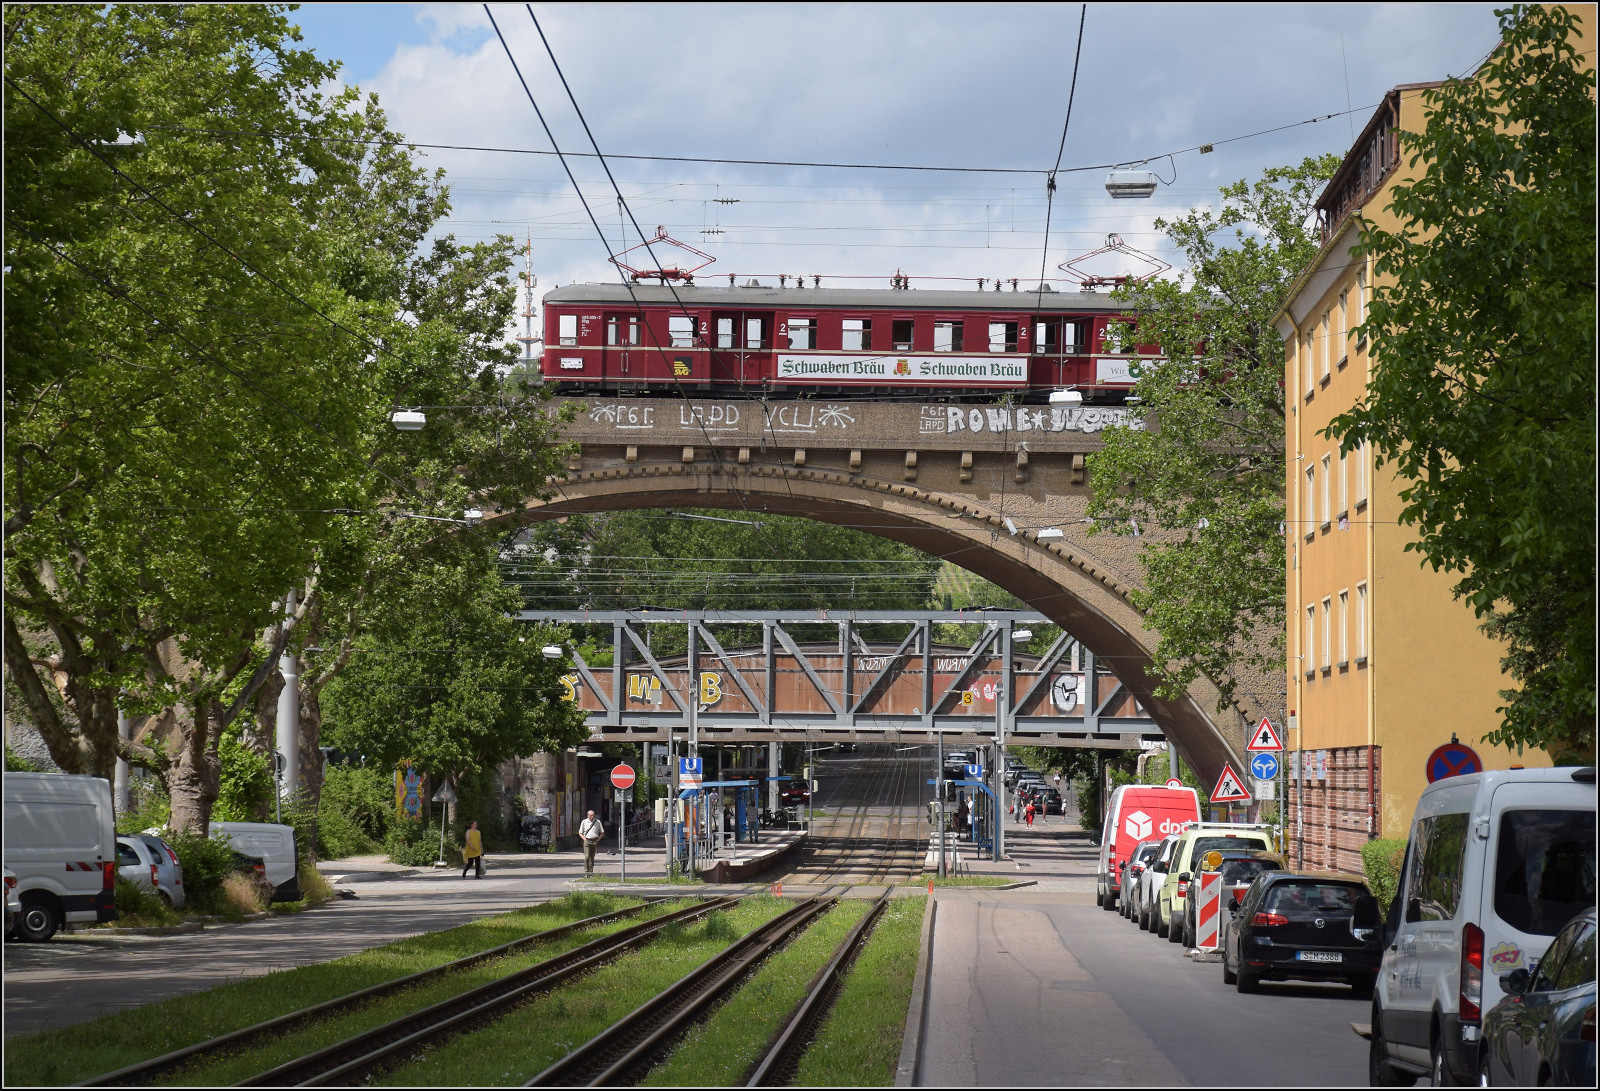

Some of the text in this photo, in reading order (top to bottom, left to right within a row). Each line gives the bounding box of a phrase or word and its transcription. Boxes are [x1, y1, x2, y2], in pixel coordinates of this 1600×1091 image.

[701, 321, 707, 331] 2
[780, 323, 786, 332] 2
[1021, 327, 1027, 336] 2
[1099, 328, 1105, 337] 2
[782, 359, 885, 375] Schwaben Bräu
[919, 361, 1022, 376] Schwaben Bräu
[1111, 367, 1126, 375] Wir
[699, 671, 721, 704] B
[964, 693, 972, 704] 3
[685, 758, 697, 771] U
[968, 765, 978, 775] U
